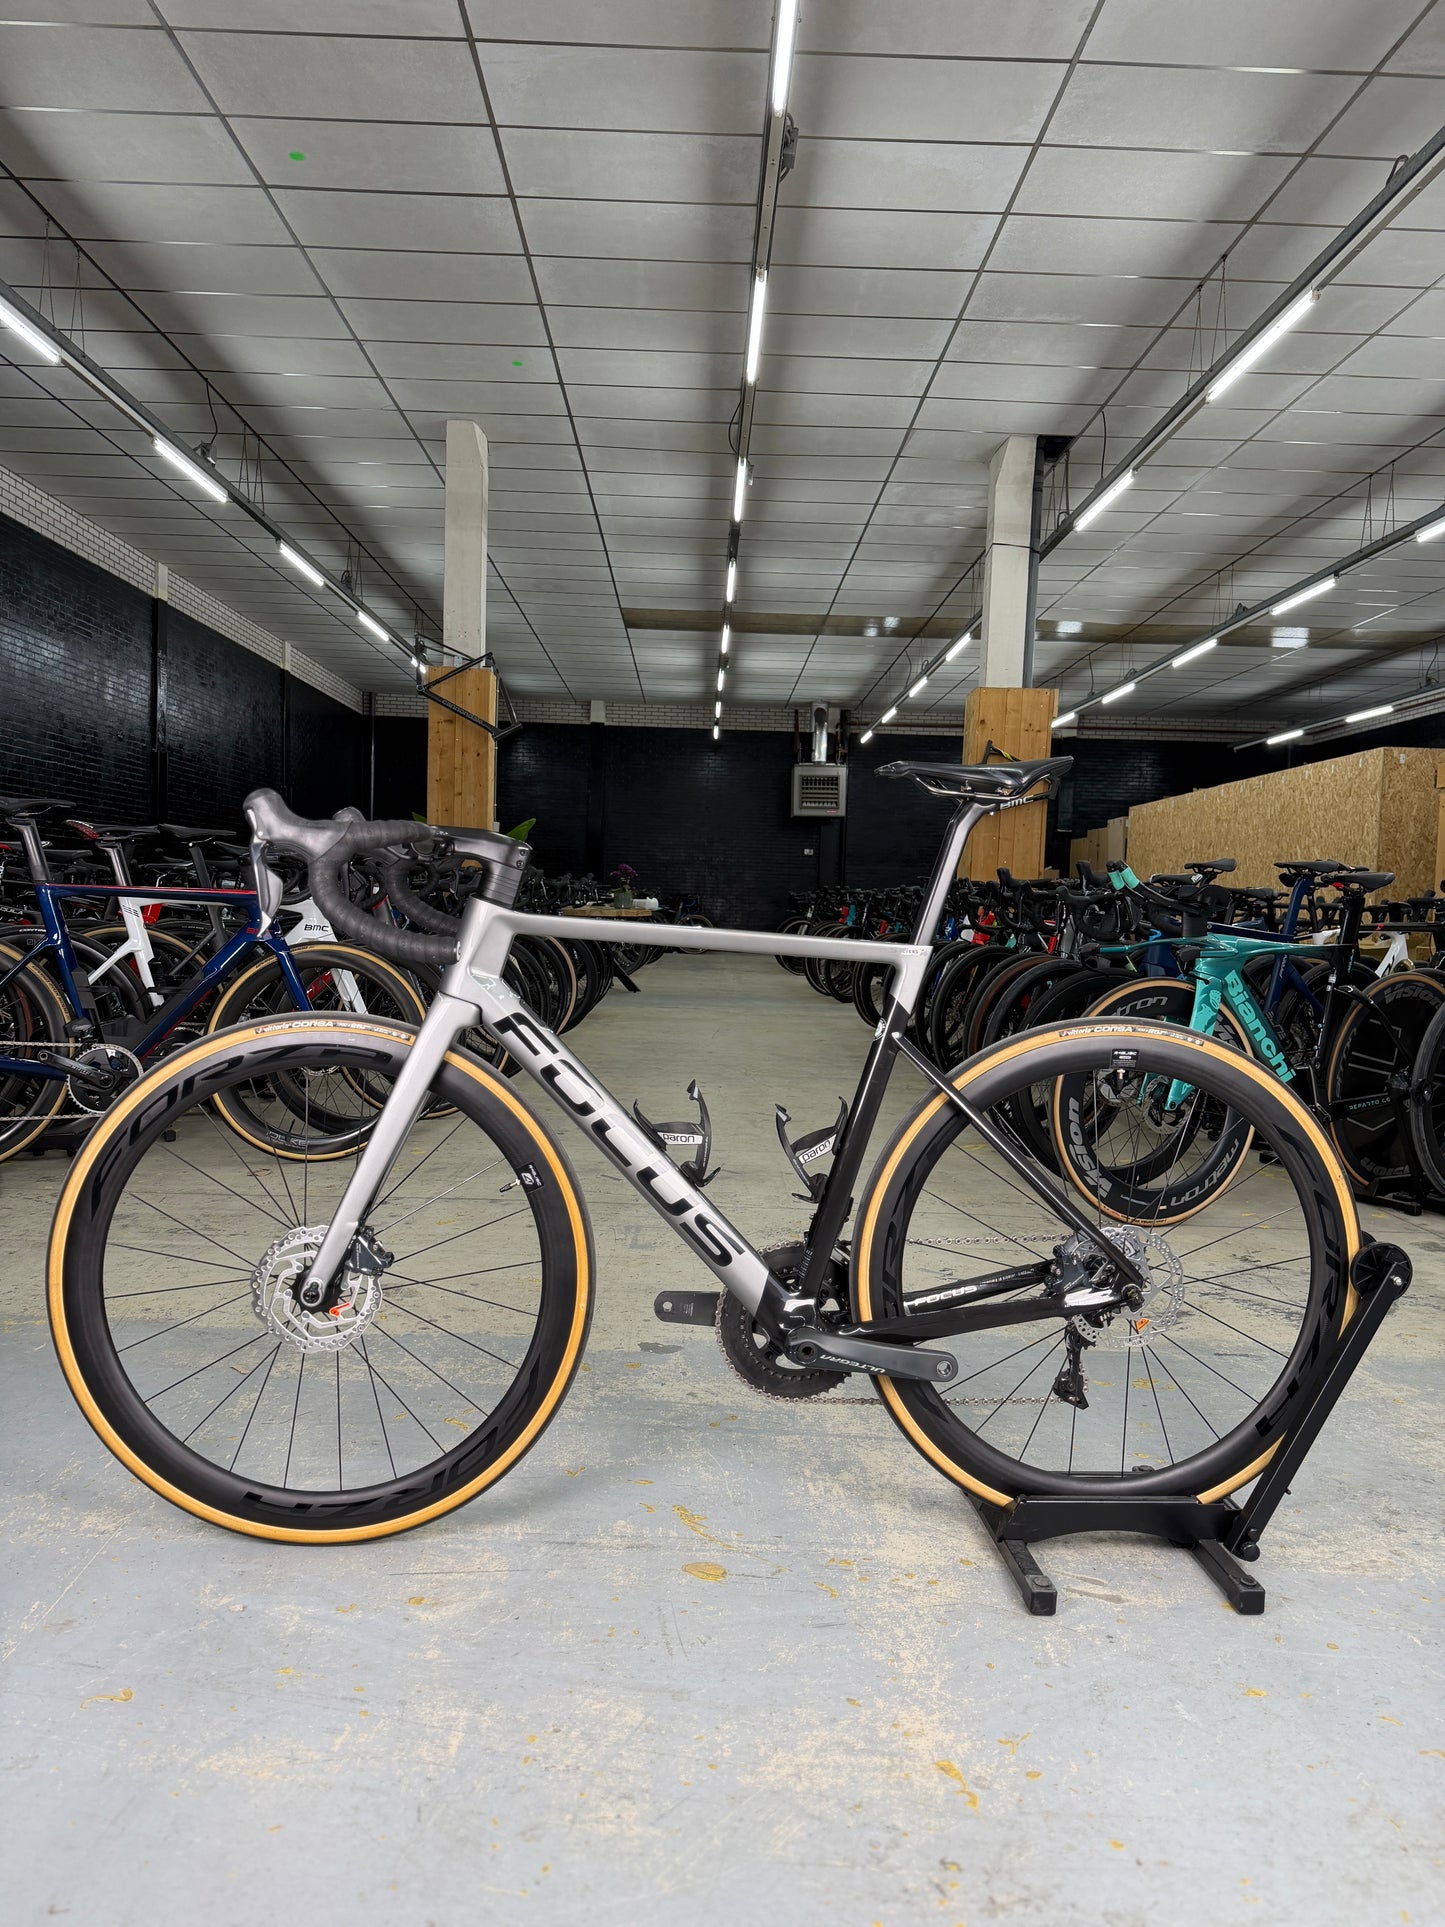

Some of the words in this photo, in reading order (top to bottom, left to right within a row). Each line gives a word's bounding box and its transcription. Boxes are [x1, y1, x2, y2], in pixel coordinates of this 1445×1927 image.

[999, 795, 1034, 810] BMC
[304, 924, 329, 932] BMC
[1111, 996, 1168, 1016] tron
[1225, 970, 1296, 1083] Bianchi
[493, 1012, 745, 1267] FOCUS
[662, 1134, 695, 1143] paron
[802, 1140, 831, 1163] paron
[1171, 1138, 1239, 1207] metron
[914, 1285, 978, 1308] FOCUS
[819, 1354, 886, 1374] ULTEGRA
